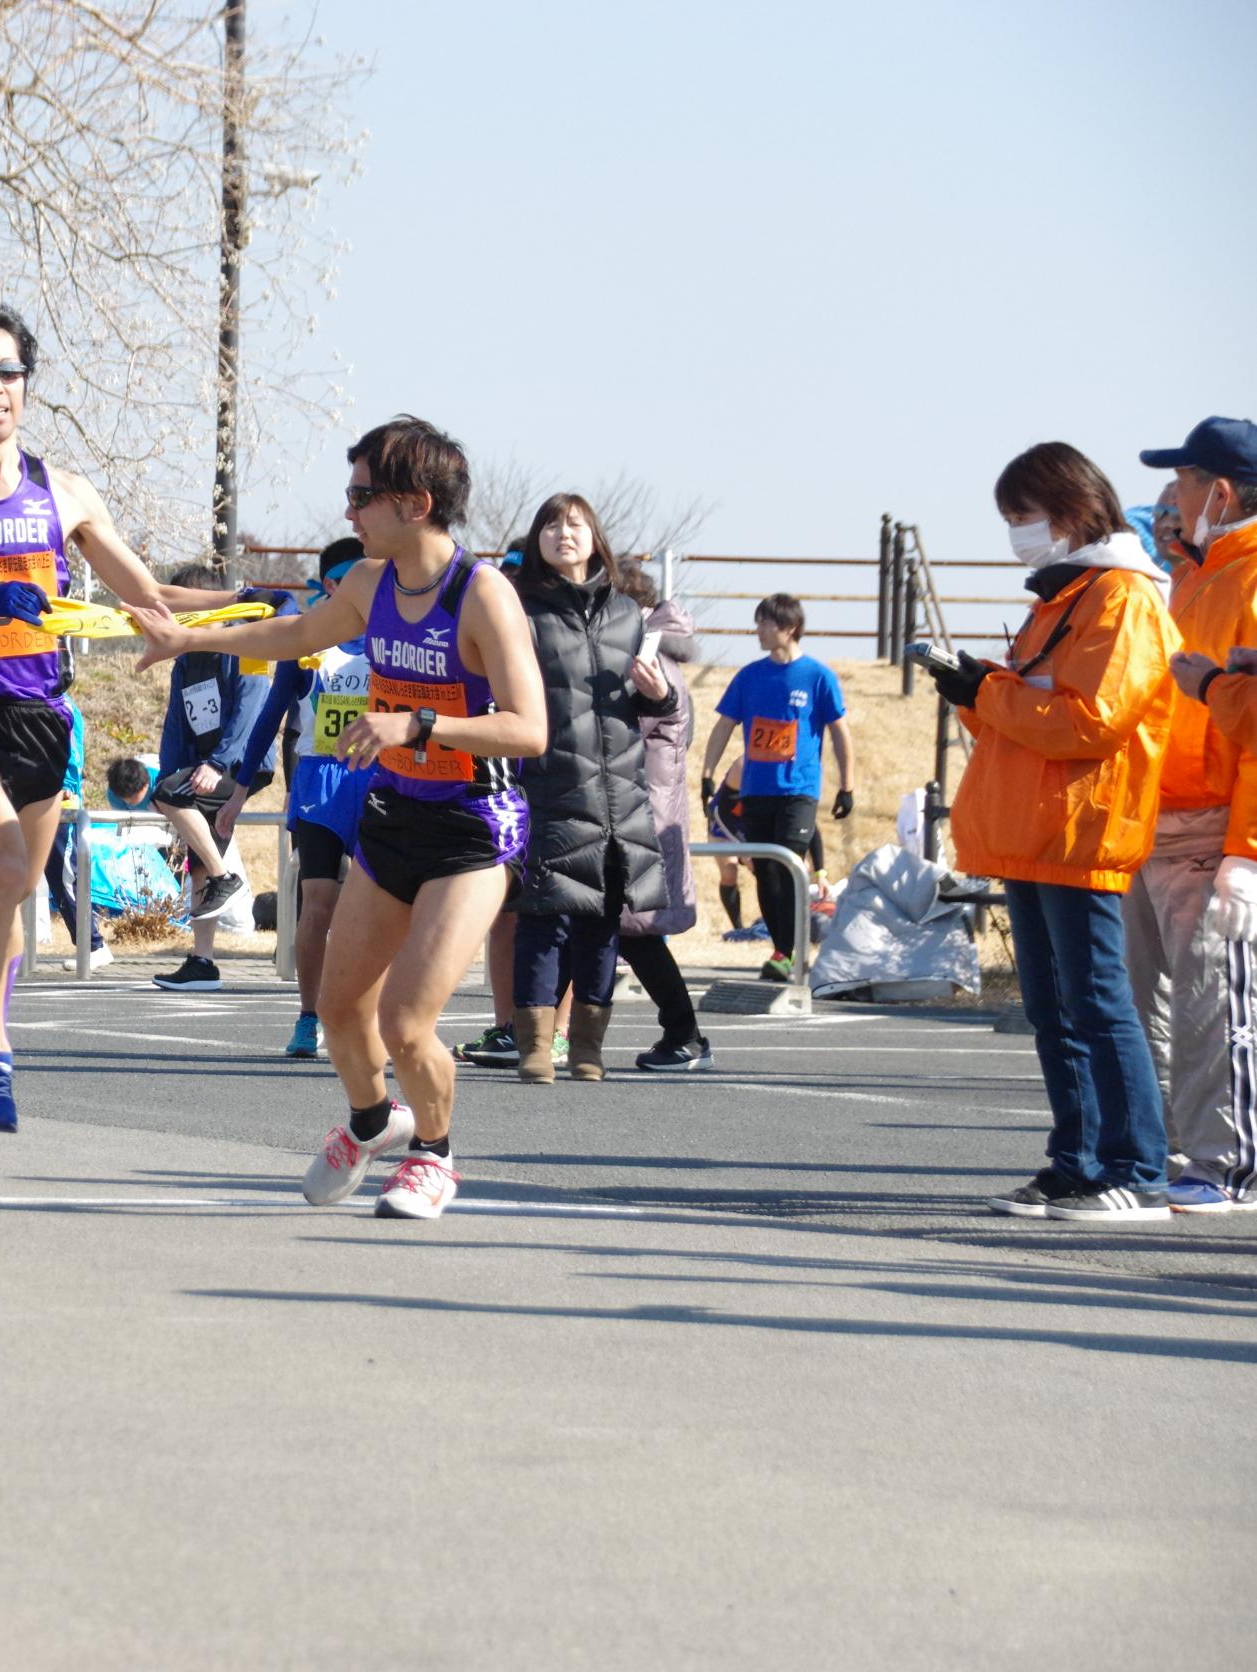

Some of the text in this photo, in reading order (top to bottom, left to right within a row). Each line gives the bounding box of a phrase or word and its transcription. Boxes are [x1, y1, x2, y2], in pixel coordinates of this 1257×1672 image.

[371, 637, 447, 677] NO-BORDER
[326, 672, 370, 692] 宮の
[185, 698, 219, 722] 2-3
